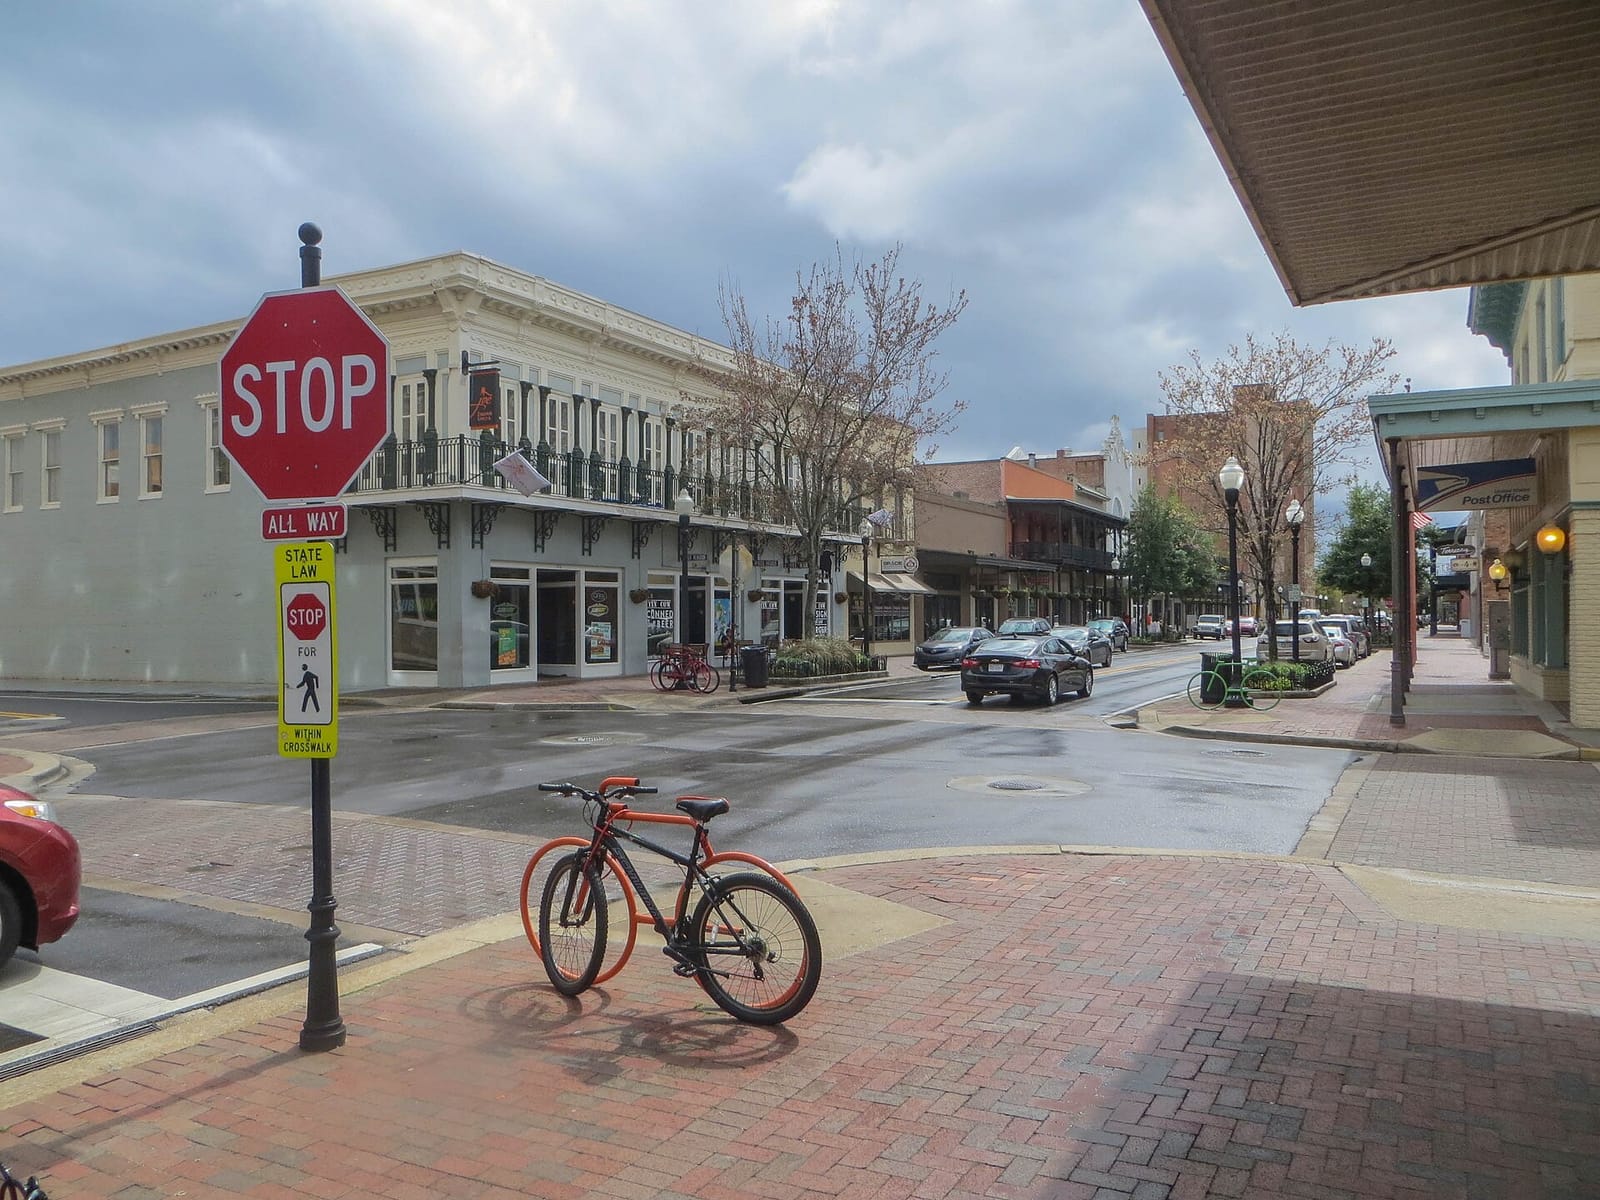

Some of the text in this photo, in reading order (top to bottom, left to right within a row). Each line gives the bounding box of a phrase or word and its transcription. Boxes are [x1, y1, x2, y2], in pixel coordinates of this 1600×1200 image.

[231, 354, 377, 437] STOP
[1462, 493, 1530, 505] Post Office
[268, 511, 339, 535] ALL WAY
[285, 548, 323, 563] STATE
[291, 564, 317, 579] LAW
[288, 608, 324, 626] STOP
[297, 646, 317, 657] FOR
[294, 728, 322, 740] WITHIN
[283, 741, 332, 753] CROSSWALK
